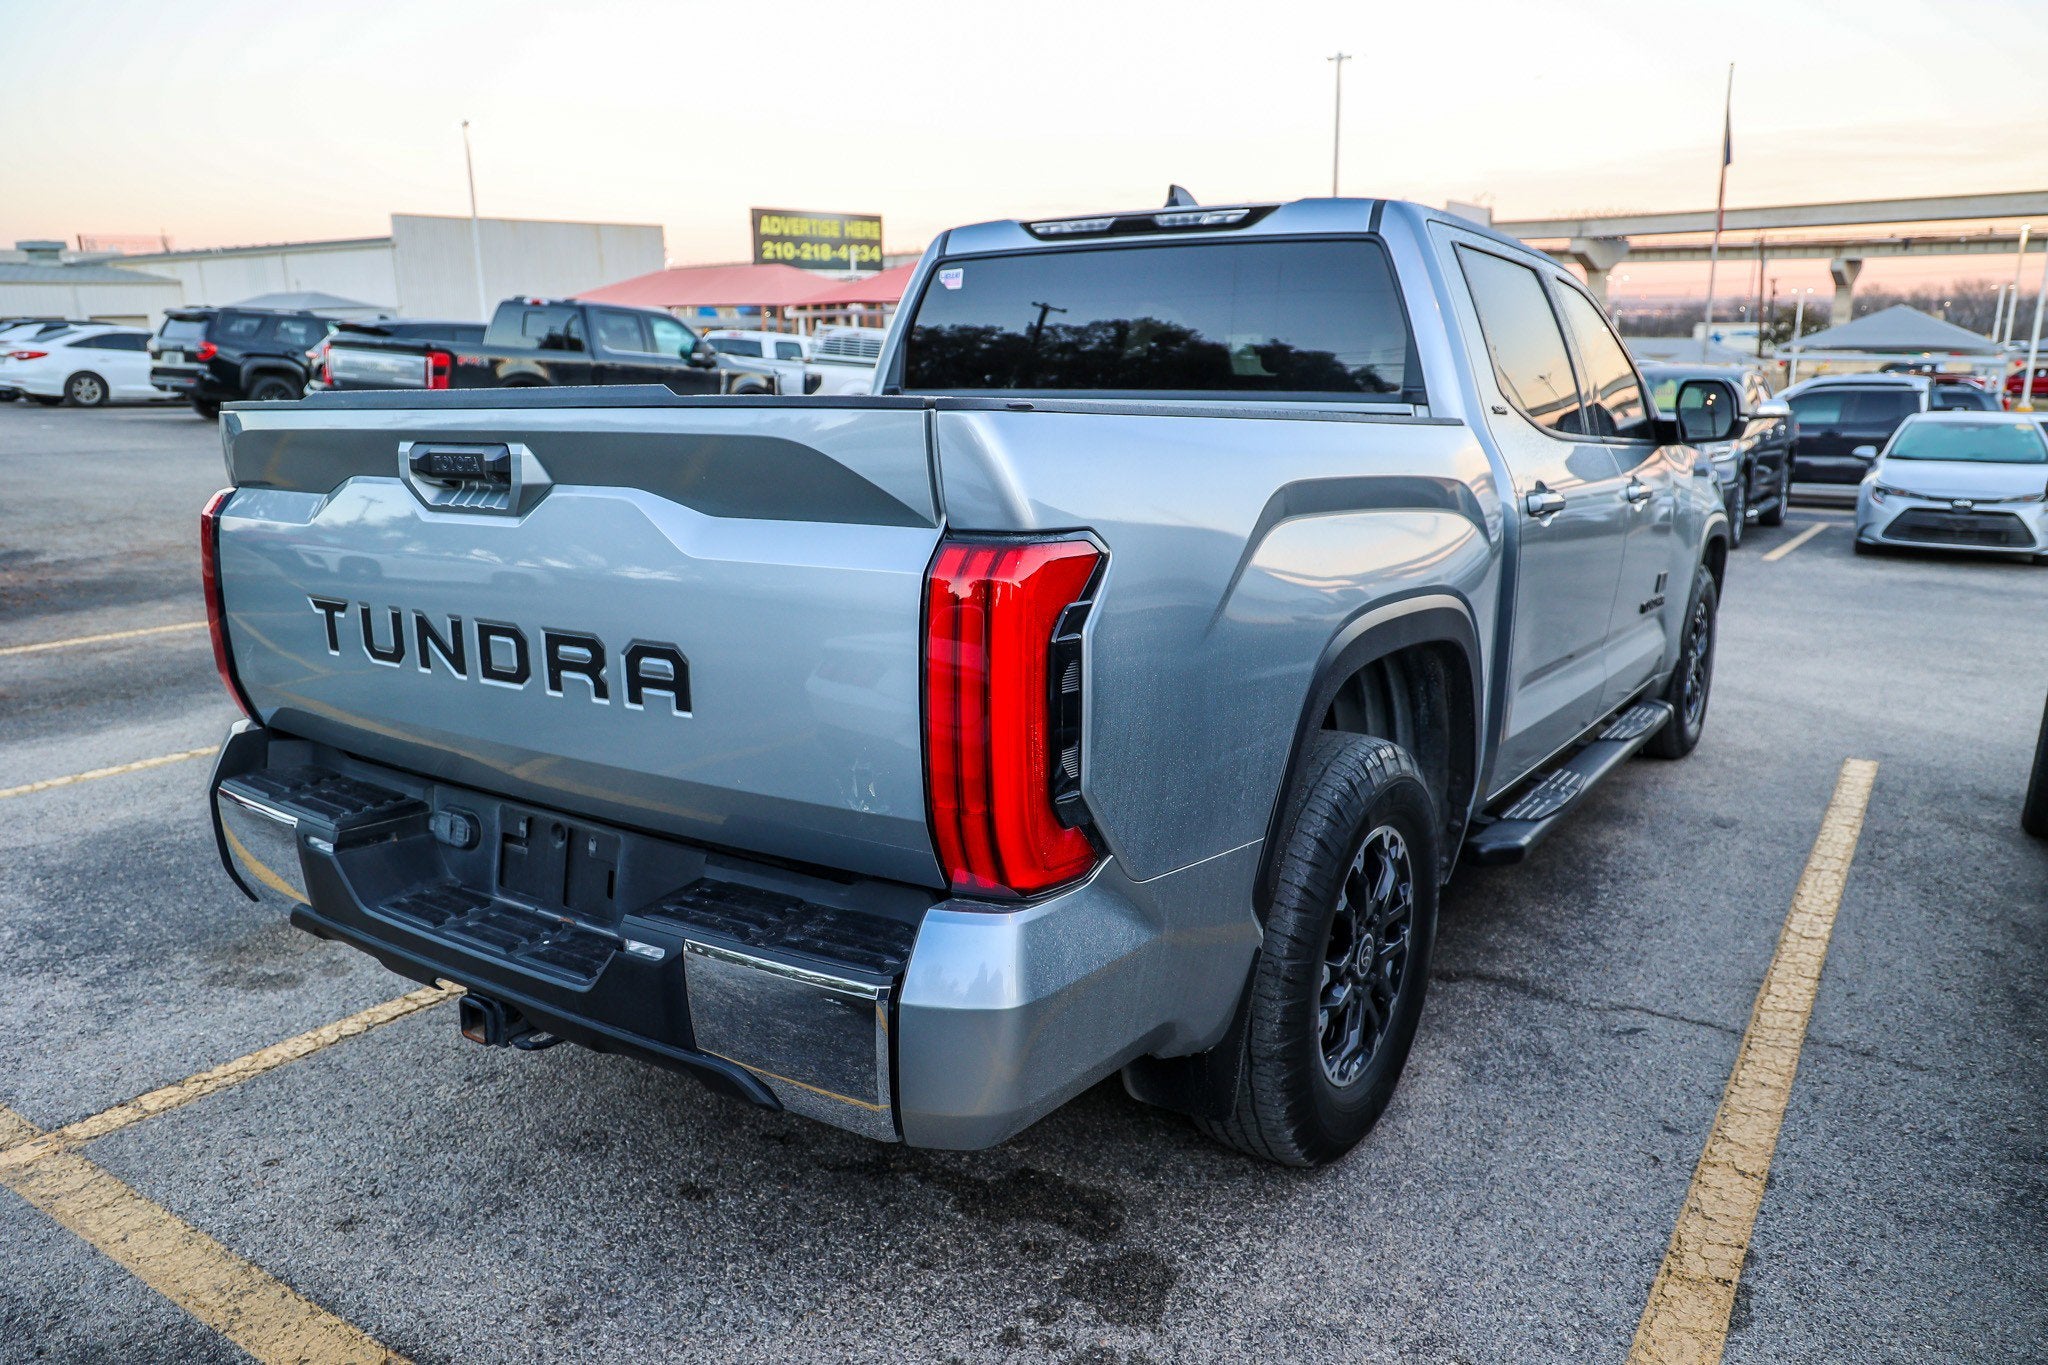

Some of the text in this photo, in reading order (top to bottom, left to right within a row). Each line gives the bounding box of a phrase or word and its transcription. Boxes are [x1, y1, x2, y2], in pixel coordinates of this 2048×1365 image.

[760, 215, 880, 239] ADVERTISE HERE
[433, 455, 481, 472] TOYOTA
[306, 593, 693, 719] TUNDRA
